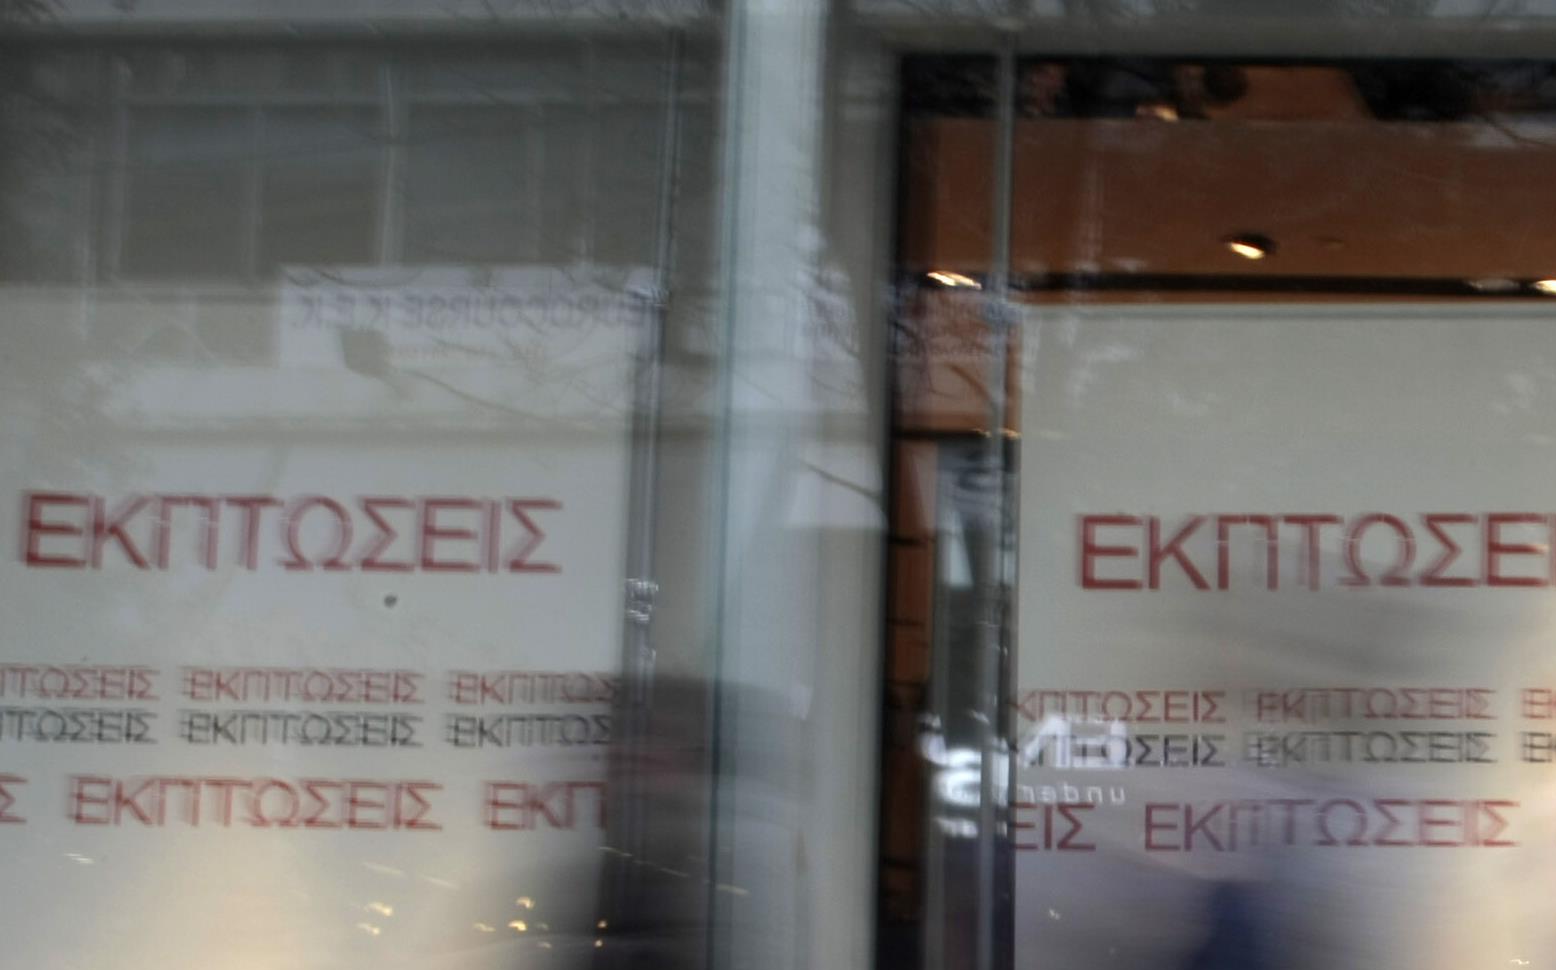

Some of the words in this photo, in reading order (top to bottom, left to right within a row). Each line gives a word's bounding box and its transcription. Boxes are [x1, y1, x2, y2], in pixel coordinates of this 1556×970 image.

[22, 493, 562, 573] ΕΚΠΤΩΣΕΙΣ
[181, 668, 424, 702] ΕΚΠΤΩΣΕΙΣ
[1250, 688, 1497, 723] ΕΚΠΤΩΣΕΙΣ
[180, 711, 422, 746] ΕΚΠΤΩΣΕΙΣ
[1246, 731, 1497, 767] ΕΚΠΤΩΣΕΙΣ
[70, 776, 442, 831] ΕΚΠΤΩΣΕΙΣ
[1144, 799, 1519, 851] ΕΚΠΤΩΣΕΙΣ
